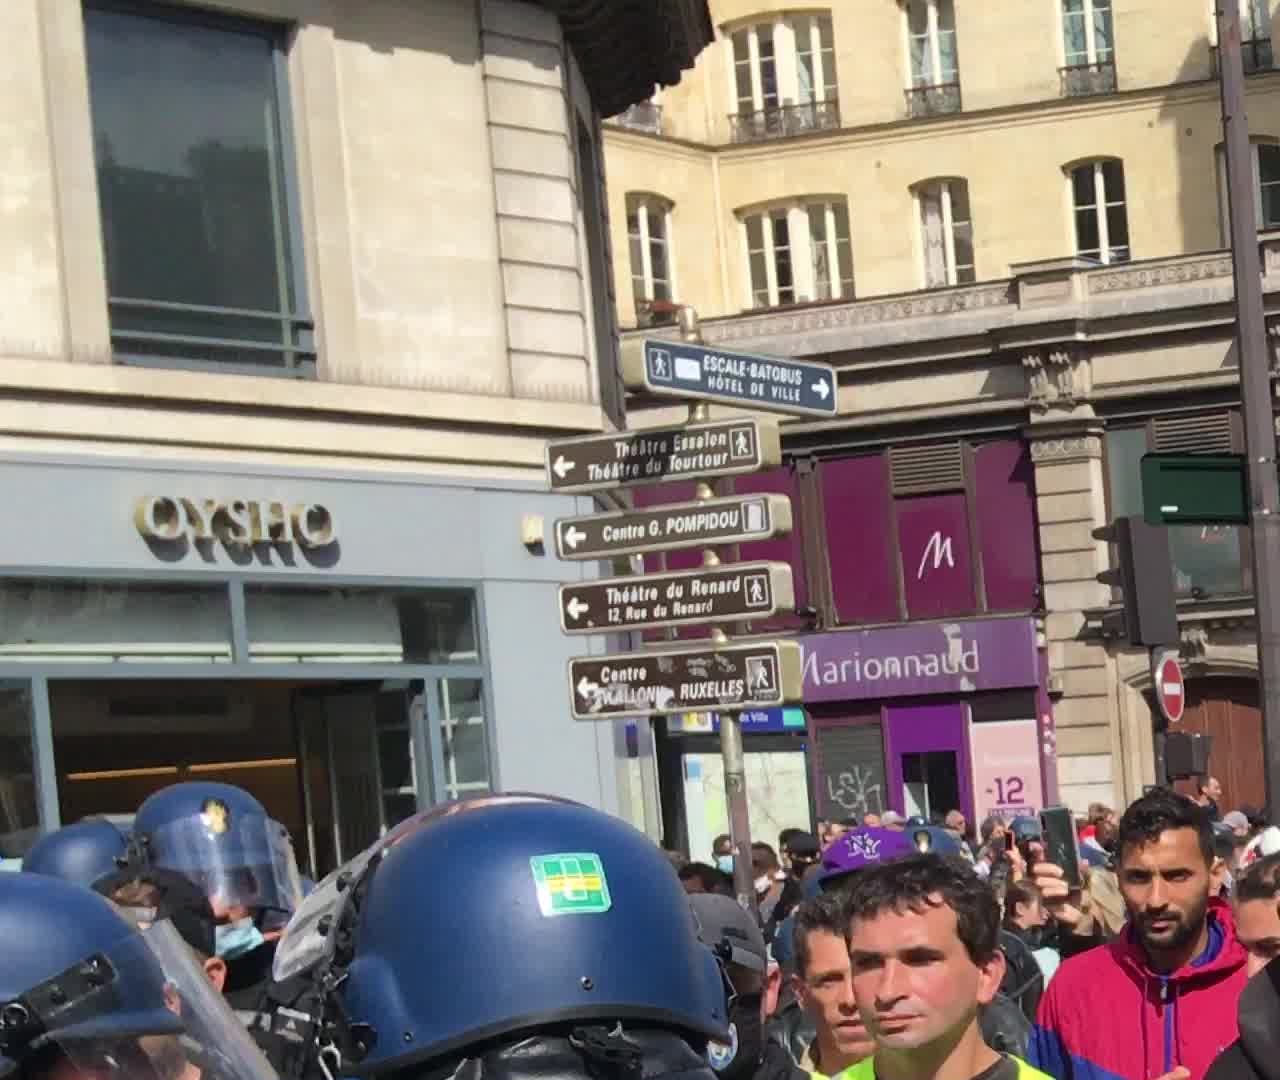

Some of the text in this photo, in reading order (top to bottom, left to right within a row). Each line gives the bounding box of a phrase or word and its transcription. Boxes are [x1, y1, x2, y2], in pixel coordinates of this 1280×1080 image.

[707, 376, 801, 402] HÔTEL DE VILLE
[645, 458, 662, 473] du
[669, 451, 728, 472] Tourtour
[133, 495, 334, 548] OYSHO
[602, 510, 739, 543] Centre G. POMPIDOU
[606, 575, 741, 605] Théâtre du Renard
[625, 604, 647, 621] Rue
[653, 601, 668, 618] du
[672, 599, 714, 615] Renard
[600, 666, 647, 684] Centre
[799, 638, 979, 688] Marionnaud
